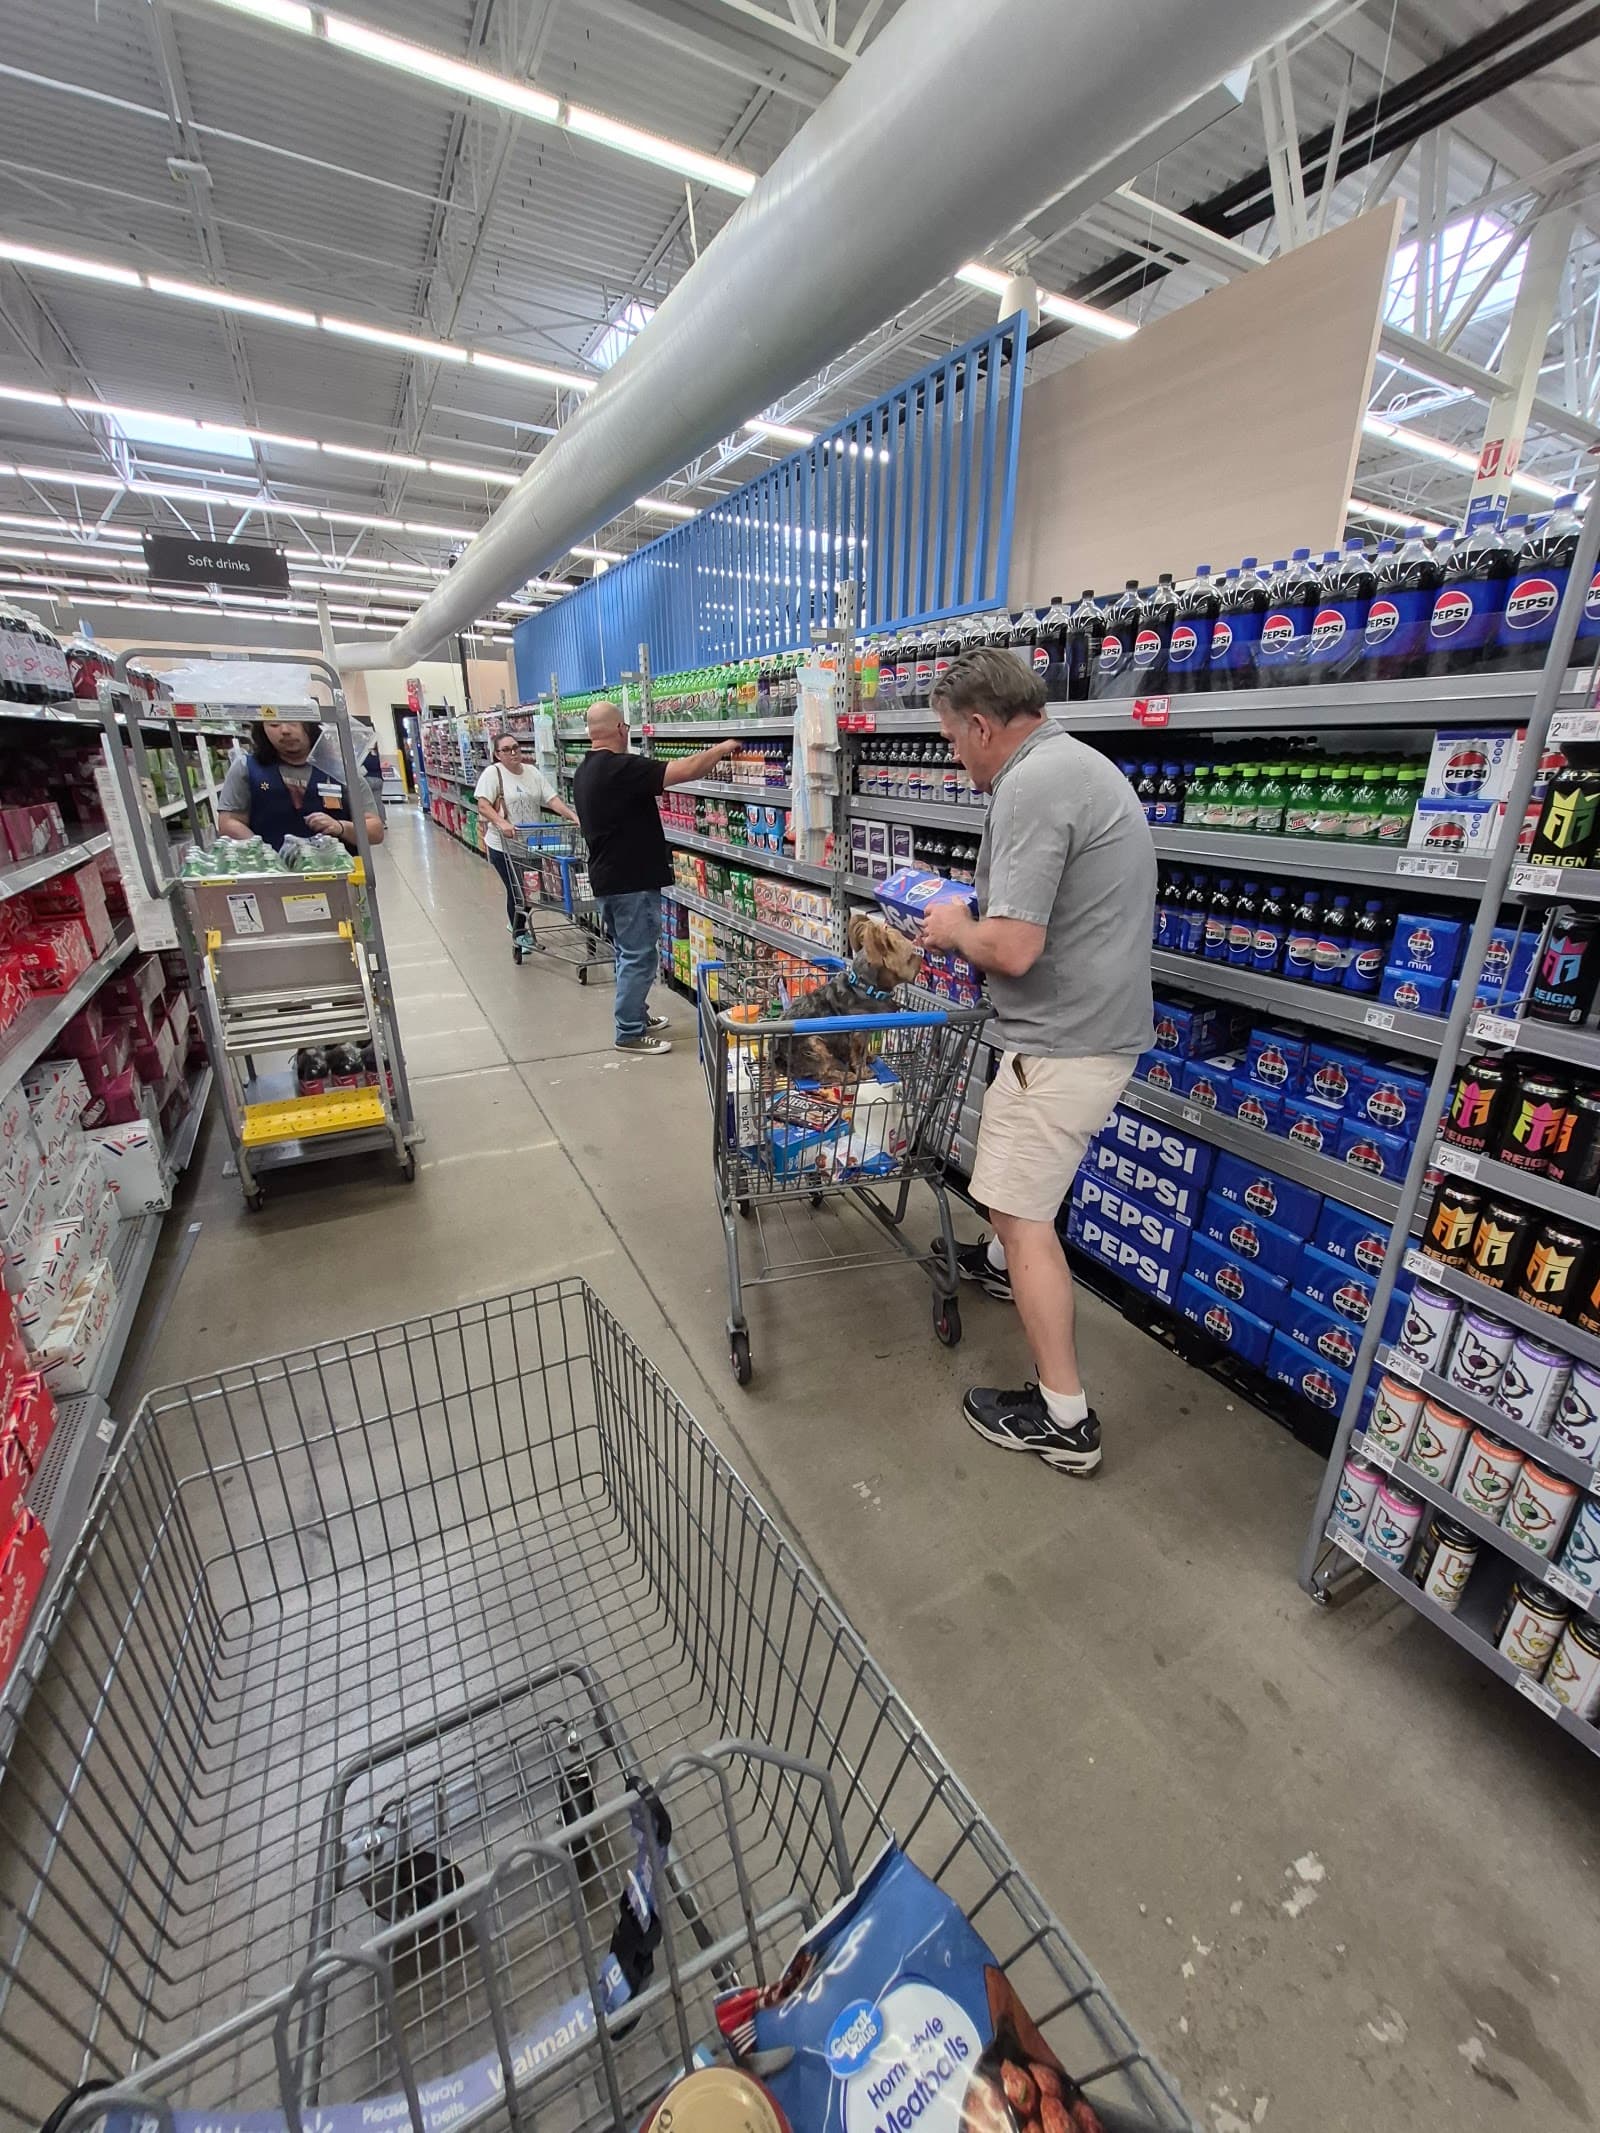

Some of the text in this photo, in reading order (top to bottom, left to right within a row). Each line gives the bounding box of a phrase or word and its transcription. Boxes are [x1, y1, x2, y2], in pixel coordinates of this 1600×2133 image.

[188, 554, 251, 573] Soft drinks
[1509, 596, 1555, 611] PEPSI
[1368, 616, 1396, 629] PEPSI
[1433, 606, 1470, 621] PEPSI
[1263, 628, 1292, 641] PEPSI
[1312, 624, 1343, 637] PEPSI
[1170, 638, 1195, 650] PEPSI
[1211, 634, 1231, 646] EPSI
[1445, 768, 1487, 780] PEPSI
[1424, 838, 1465, 849] PEPSI
[1531, 853, 1588, 867] REIGN
[1408, 939, 1432, 950] PEPSI
[1358, 959, 1382, 969] PEP
[1407, 961, 1432, 972] mini
[1480, 974, 1503, 985] min
[1396, 991, 1420, 1003] PEPSI
[1534, 987, 1577, 1005] REIGN
[1259, 1060, 1288, 1076] PEPSI
[1316, 1075, 1347, 1091] PEPSI
[1239, 1108, 1267, 1126] PEPSI
[1369, 1100, 1406, 1117] PEPSI
[742, 1104, 750, 1133] ULTRA
[1096, 1111, 1198, 1175] PEPSI
[1291, 1131, 1323, 1150] PEPSI
[1349, 1151, 1384, 1171] PEPSI
[1097, 1146, 1189, 1214] PEPSI
[144, 1197, 166, 1210] 24
[1246, 1192, 1274, 1210] PEPSI
[1081, 1179, 1175, 1253] PEPSI
[1232, 1233, 1258, 1251] PEPSI
[1082, 1219, 1170, 1292] PEPSI
[1357, 1248, 1384, 1266] PEPS
[1217, 1275, 1242, 1293] PEPSI
[1335, 1295, 1368, 1316] PEPSI
[1206, 1316, 1231, 1336] PEPSI
[1319, 1338, 1353, 1361] PEPSI
[1304, 1380, 1335, 1404] PEPSI
[831, 2009, 871, 2059] Great
[850, 2023, 878, 2060] Value
[485, 2004, 591, 2092] Walmart
[874, 2035, 969, 2133] Meatballs
[362, 2097, 411, 2125] Please
